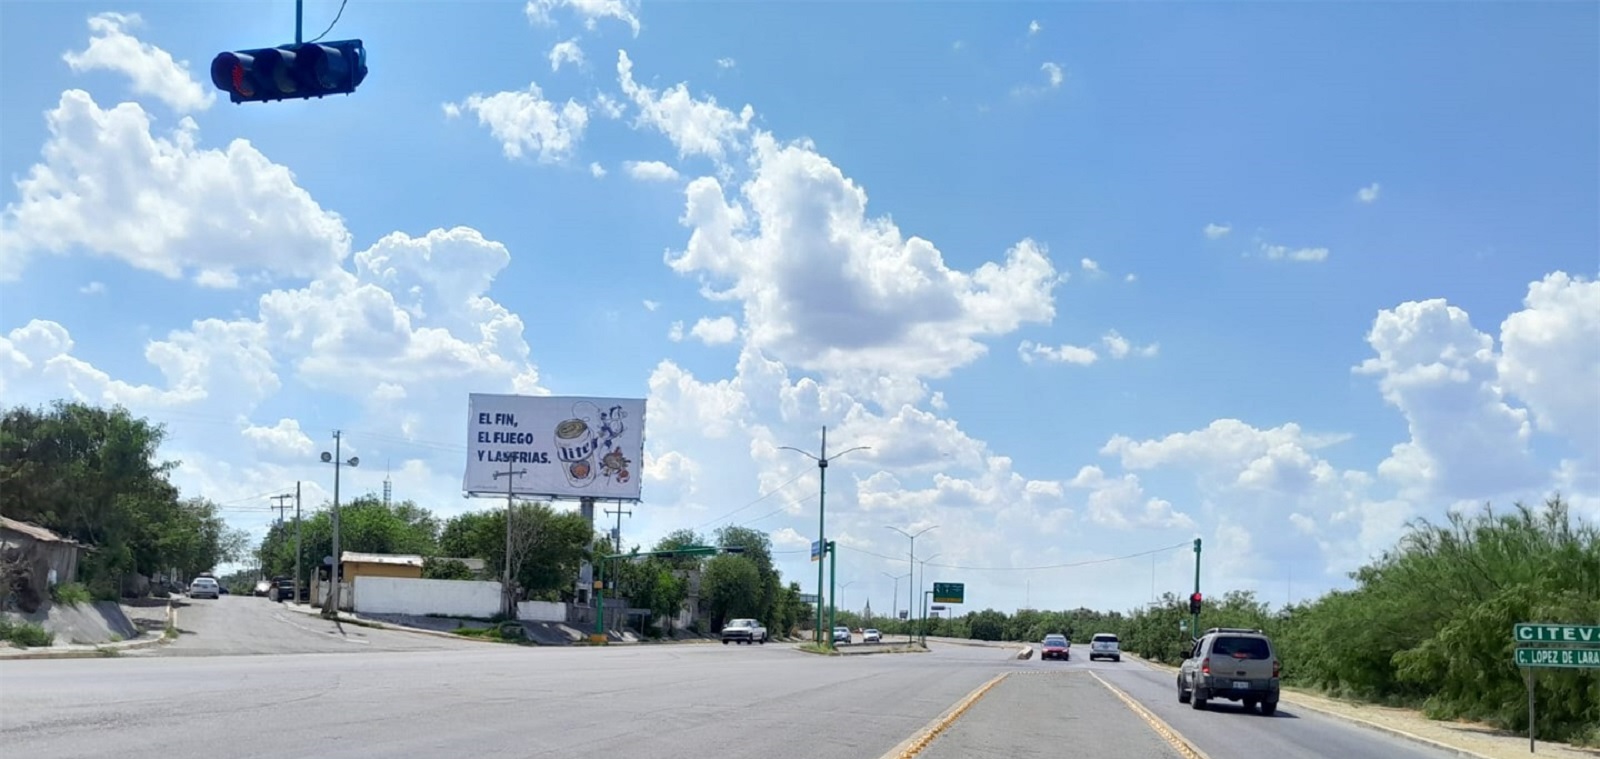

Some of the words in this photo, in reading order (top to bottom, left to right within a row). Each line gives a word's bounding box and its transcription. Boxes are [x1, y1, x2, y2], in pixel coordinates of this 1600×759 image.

[479, 412, 492, 425] EL
[495, 413, 518, 428] FIN,
[478, 431, 491, 443] EL
[493, 432, 534, 445] FUEGO
[477, 450, 485, 461] Y
[511, 451, 552, 464] FRIAS.
[1519, 627, 1600, 640] CITEV
[1531, 650, 1559, 664] LOPEZ
[1562, 651, 1573, 664] DE
